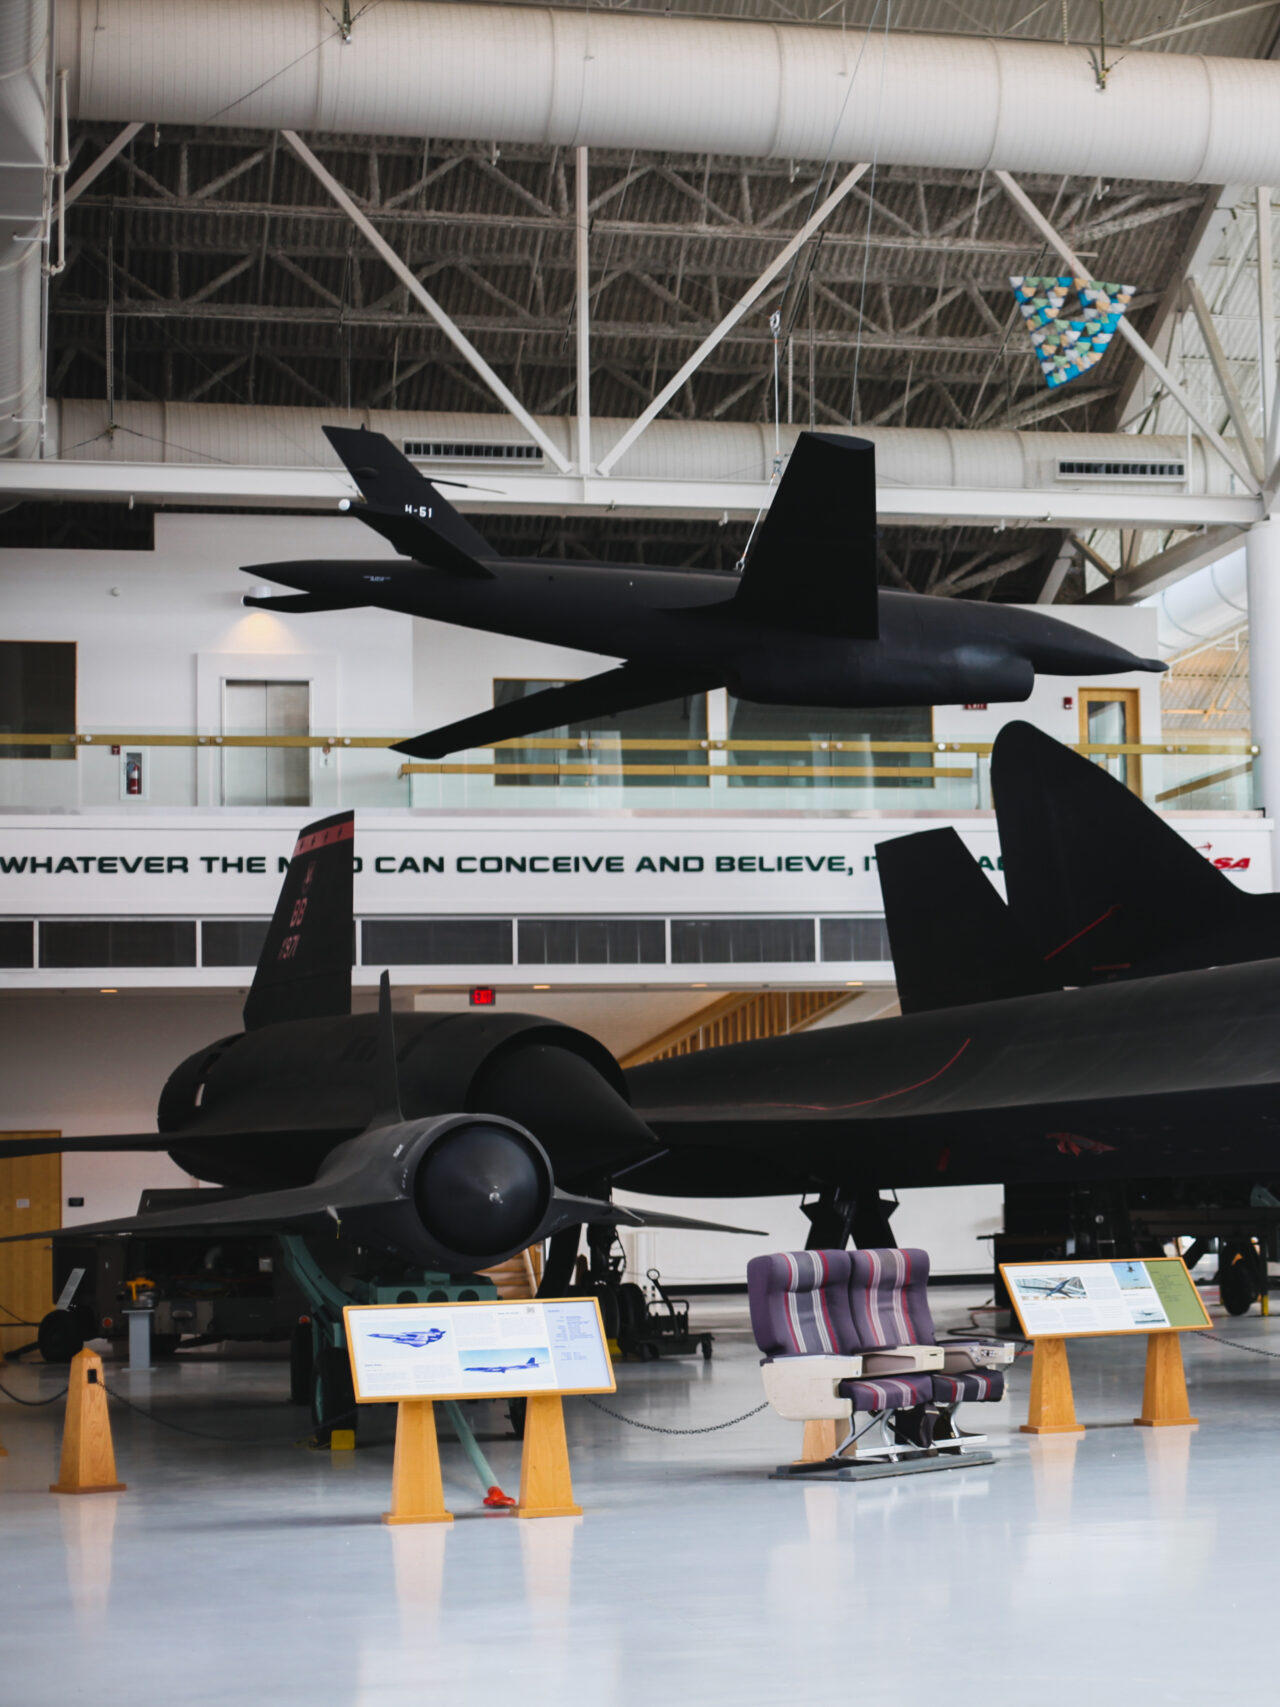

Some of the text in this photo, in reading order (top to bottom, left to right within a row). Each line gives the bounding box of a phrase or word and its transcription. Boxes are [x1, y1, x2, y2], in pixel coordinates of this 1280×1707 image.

[0, 856, 188, 873] WHATEVER
[199, 856, 266, 873] THE
[374, 856, 444, 872] CAN
[456, 856, 624, 872] CONCEIVE
[635, 856, 703, 872] AND
[715, 856, 853, 876] BELIEVE,
